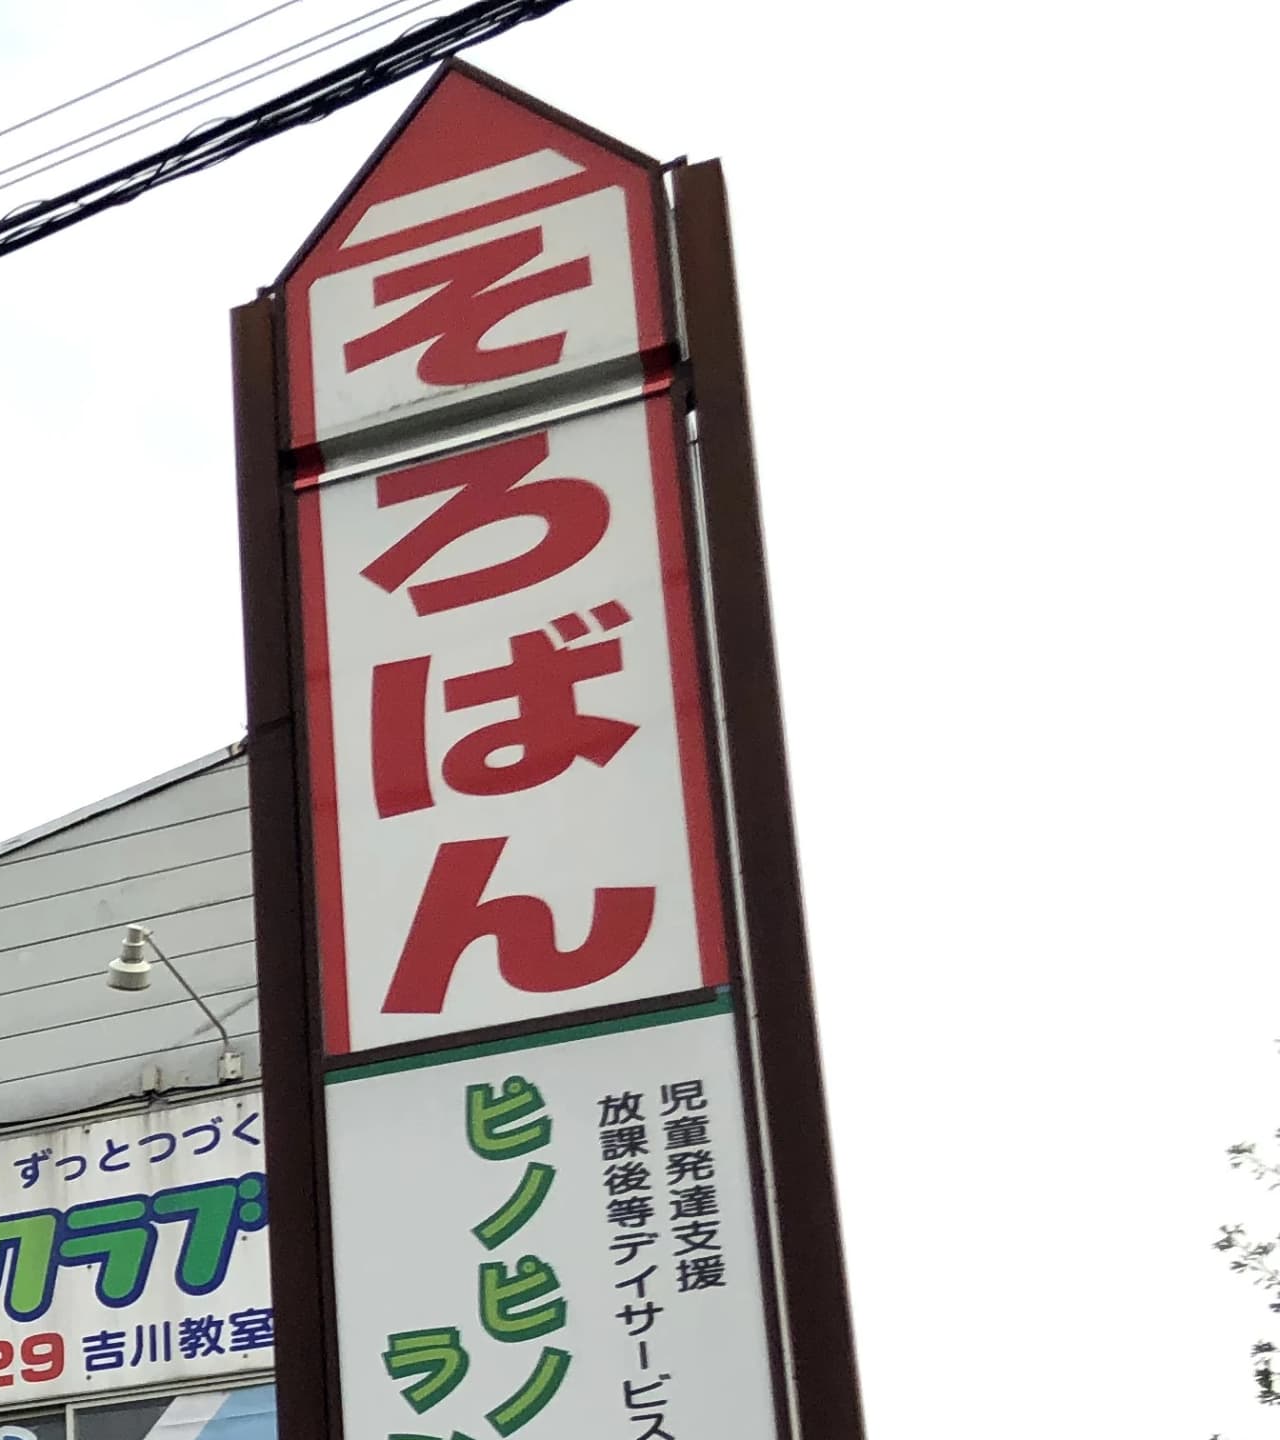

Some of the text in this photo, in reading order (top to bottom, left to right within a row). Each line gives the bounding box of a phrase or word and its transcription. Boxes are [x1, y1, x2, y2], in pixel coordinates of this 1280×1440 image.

[343, 227, 655, 1014] そろばん
[13, 1112, 261, 1188] ずっとつづく
[466, 1075, 572, 1437] ピノピノ
[660, 1079, 727, 1293] 児童発達支援
[82, 1307, 275, 1371] 吉川教室
